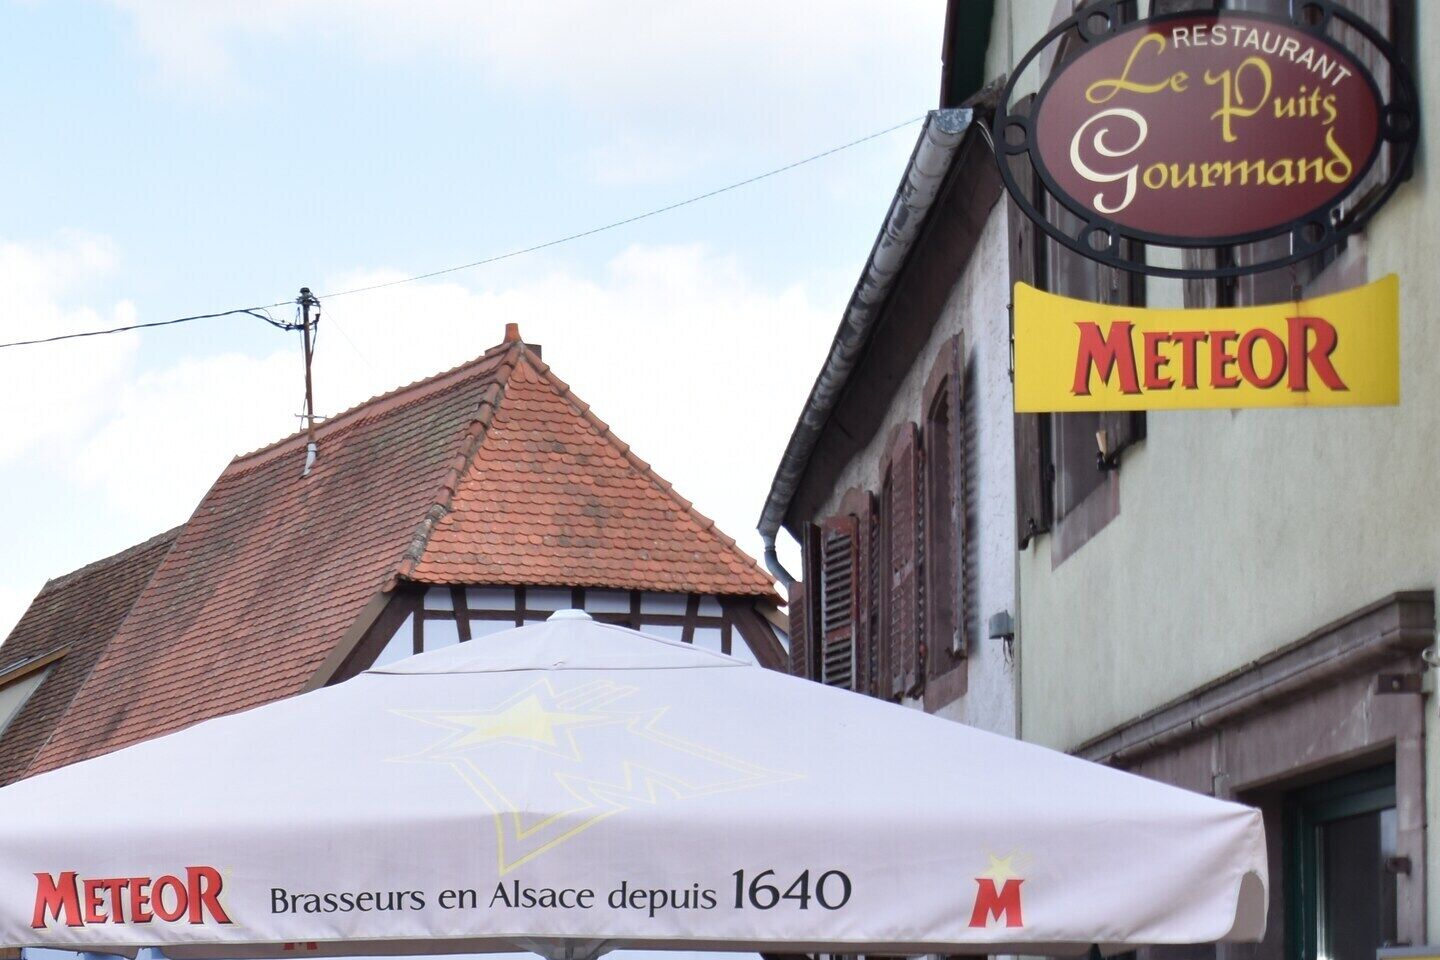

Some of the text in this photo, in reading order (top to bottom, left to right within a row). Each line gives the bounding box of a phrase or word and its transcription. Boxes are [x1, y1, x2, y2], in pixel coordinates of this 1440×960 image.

[1085, 33, 1337, 143] Le Puits
[1172, 25, 1351, 86] RESTAURANT
[1069, 107, 1352, 214] Gourmand
[1071, 316, 1350, 397] METEOR
[30, 865, 1026, 930] METEOR Brasseurs en Alsace depuis 1640 M
